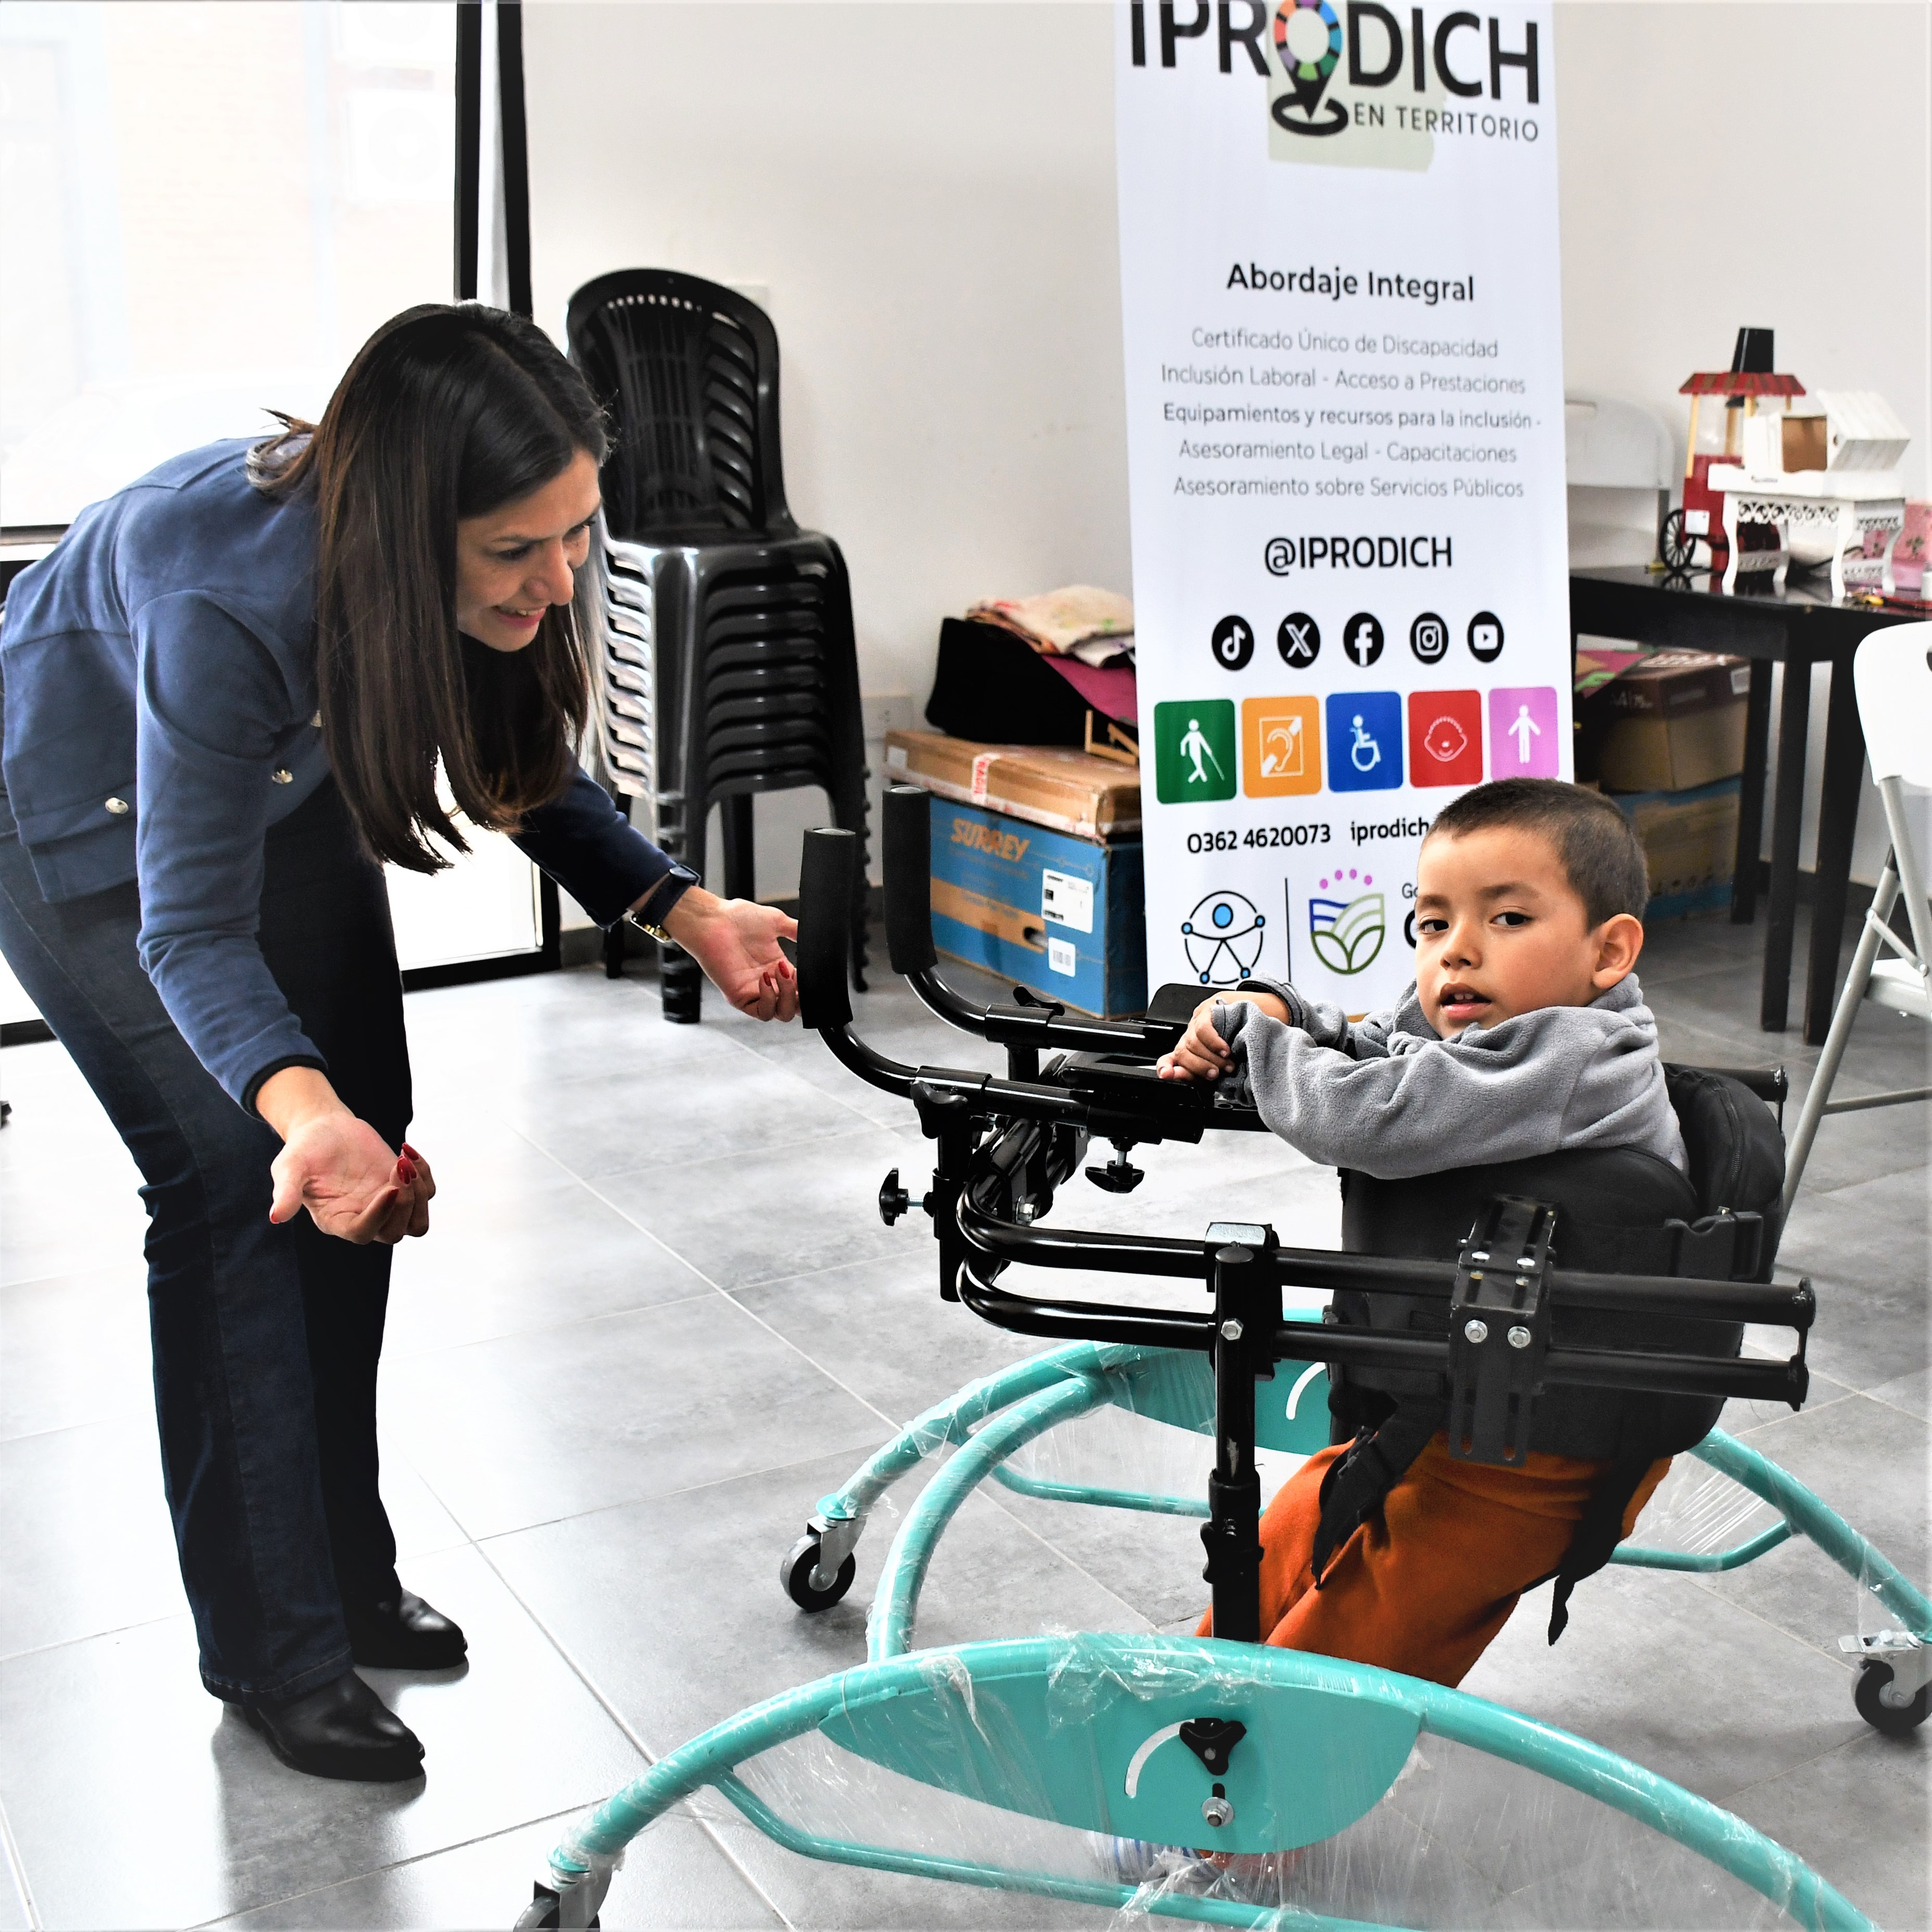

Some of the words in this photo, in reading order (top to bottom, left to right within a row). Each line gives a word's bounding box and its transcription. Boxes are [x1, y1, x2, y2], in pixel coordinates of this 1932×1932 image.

[1353, 102, 1385, 128] EN
[1397, 106, 1540, 143] TERRITORIO
[1226, 262, 1359, 301] Abordaje
[1368, 270, 1475, 306] Integral
[1192, 327, 1293, 350] Certificado
[1299, 328, 1349, 352] Único
[1355, 334, 1377, 353] de
[1383, 335, 1498, 358] Discapacidad
[1162, 364, 1243, 385] Inclusión
[1250, 366, 1316, 387] Laboral
[1336, 369, 1399, 390] Acceso
[1404, 375, 1415, 390] a
[1420, 371, 1526, 394] Prestaciones
[1163, 402, 1300, 426] Equipamientos
[1305, 410, 1315, 428] y
[1320, 410, 1394, 425] recursos
[1399, 411, 1435, 429] para
[1441, 410, 1455, 427] la
[1459, 410, 1532, 428] inclusión
[1179, 439, 1315, 460] Asesoramiento
[1321, 441, 1368, 464] Legal
[1387, 441, 1517, 463] Capacitaciones
[1174, 476, 1310, 496] Asesoramiento
[1315, 477, 1365, 496] sobre
[1370, 476, 1447, 497] Servicios
[1454, 478, 1524, 498] Públicos
[1265, 535, 1453, 577] @IPRODICH
[1187, 829, 1238, 854] 0362
[1243, 823, 1331, 849] 4620073
